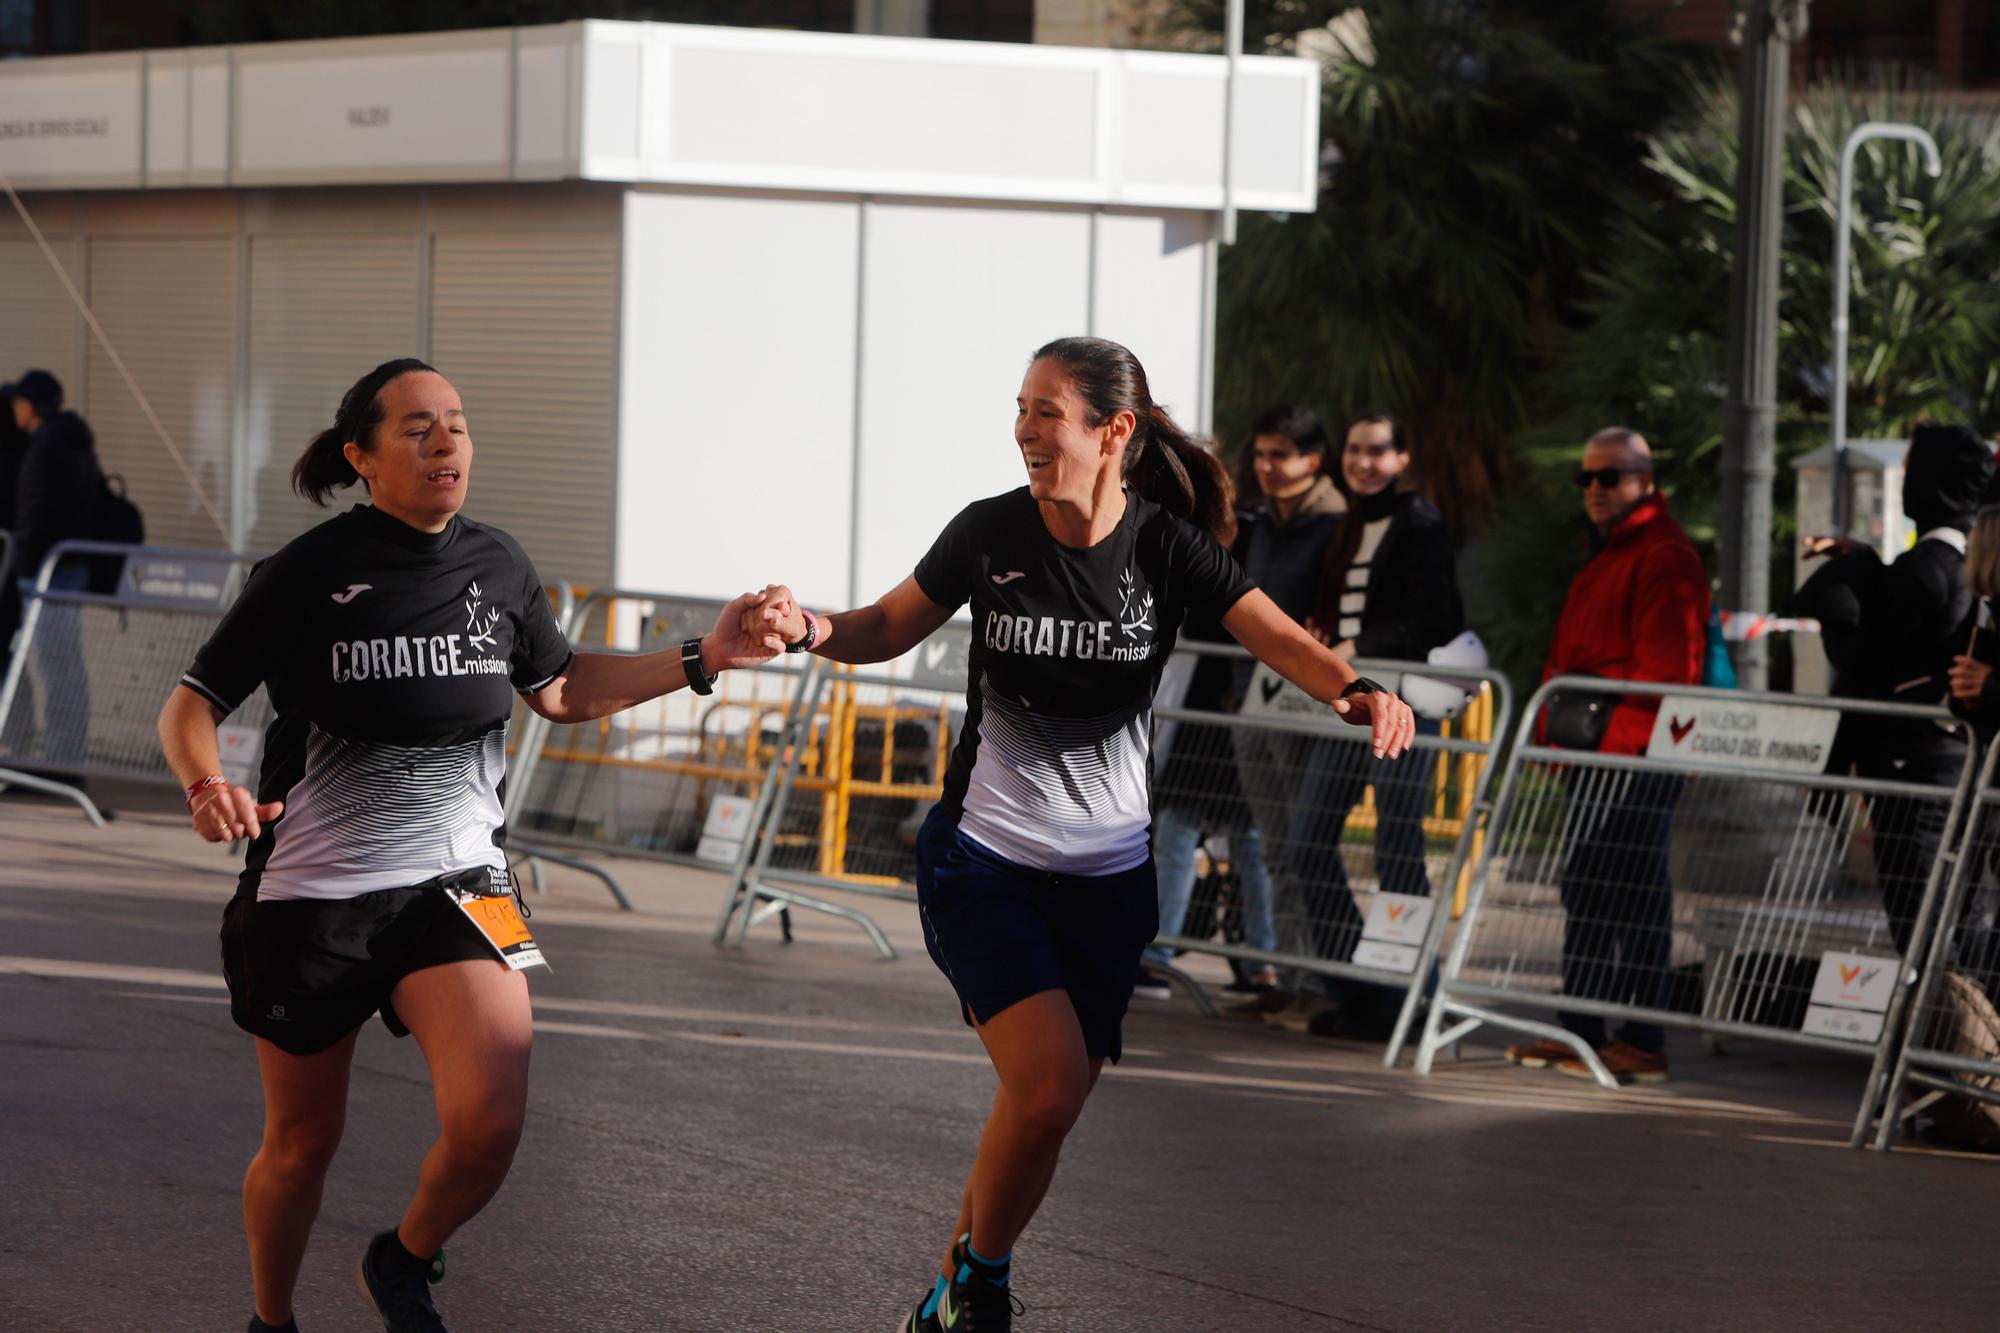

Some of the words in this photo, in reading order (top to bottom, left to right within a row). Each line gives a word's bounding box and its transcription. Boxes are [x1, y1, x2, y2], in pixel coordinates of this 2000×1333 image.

[332, 634, 466, 683] CORATGE
[985, 610, 1112, 660] CORATGE
[1691, 733, 1739, 755] CIUDAD
[1739, 737, 1762, 757] DEL
[1766, 740, 1821, 763] RUNNING
